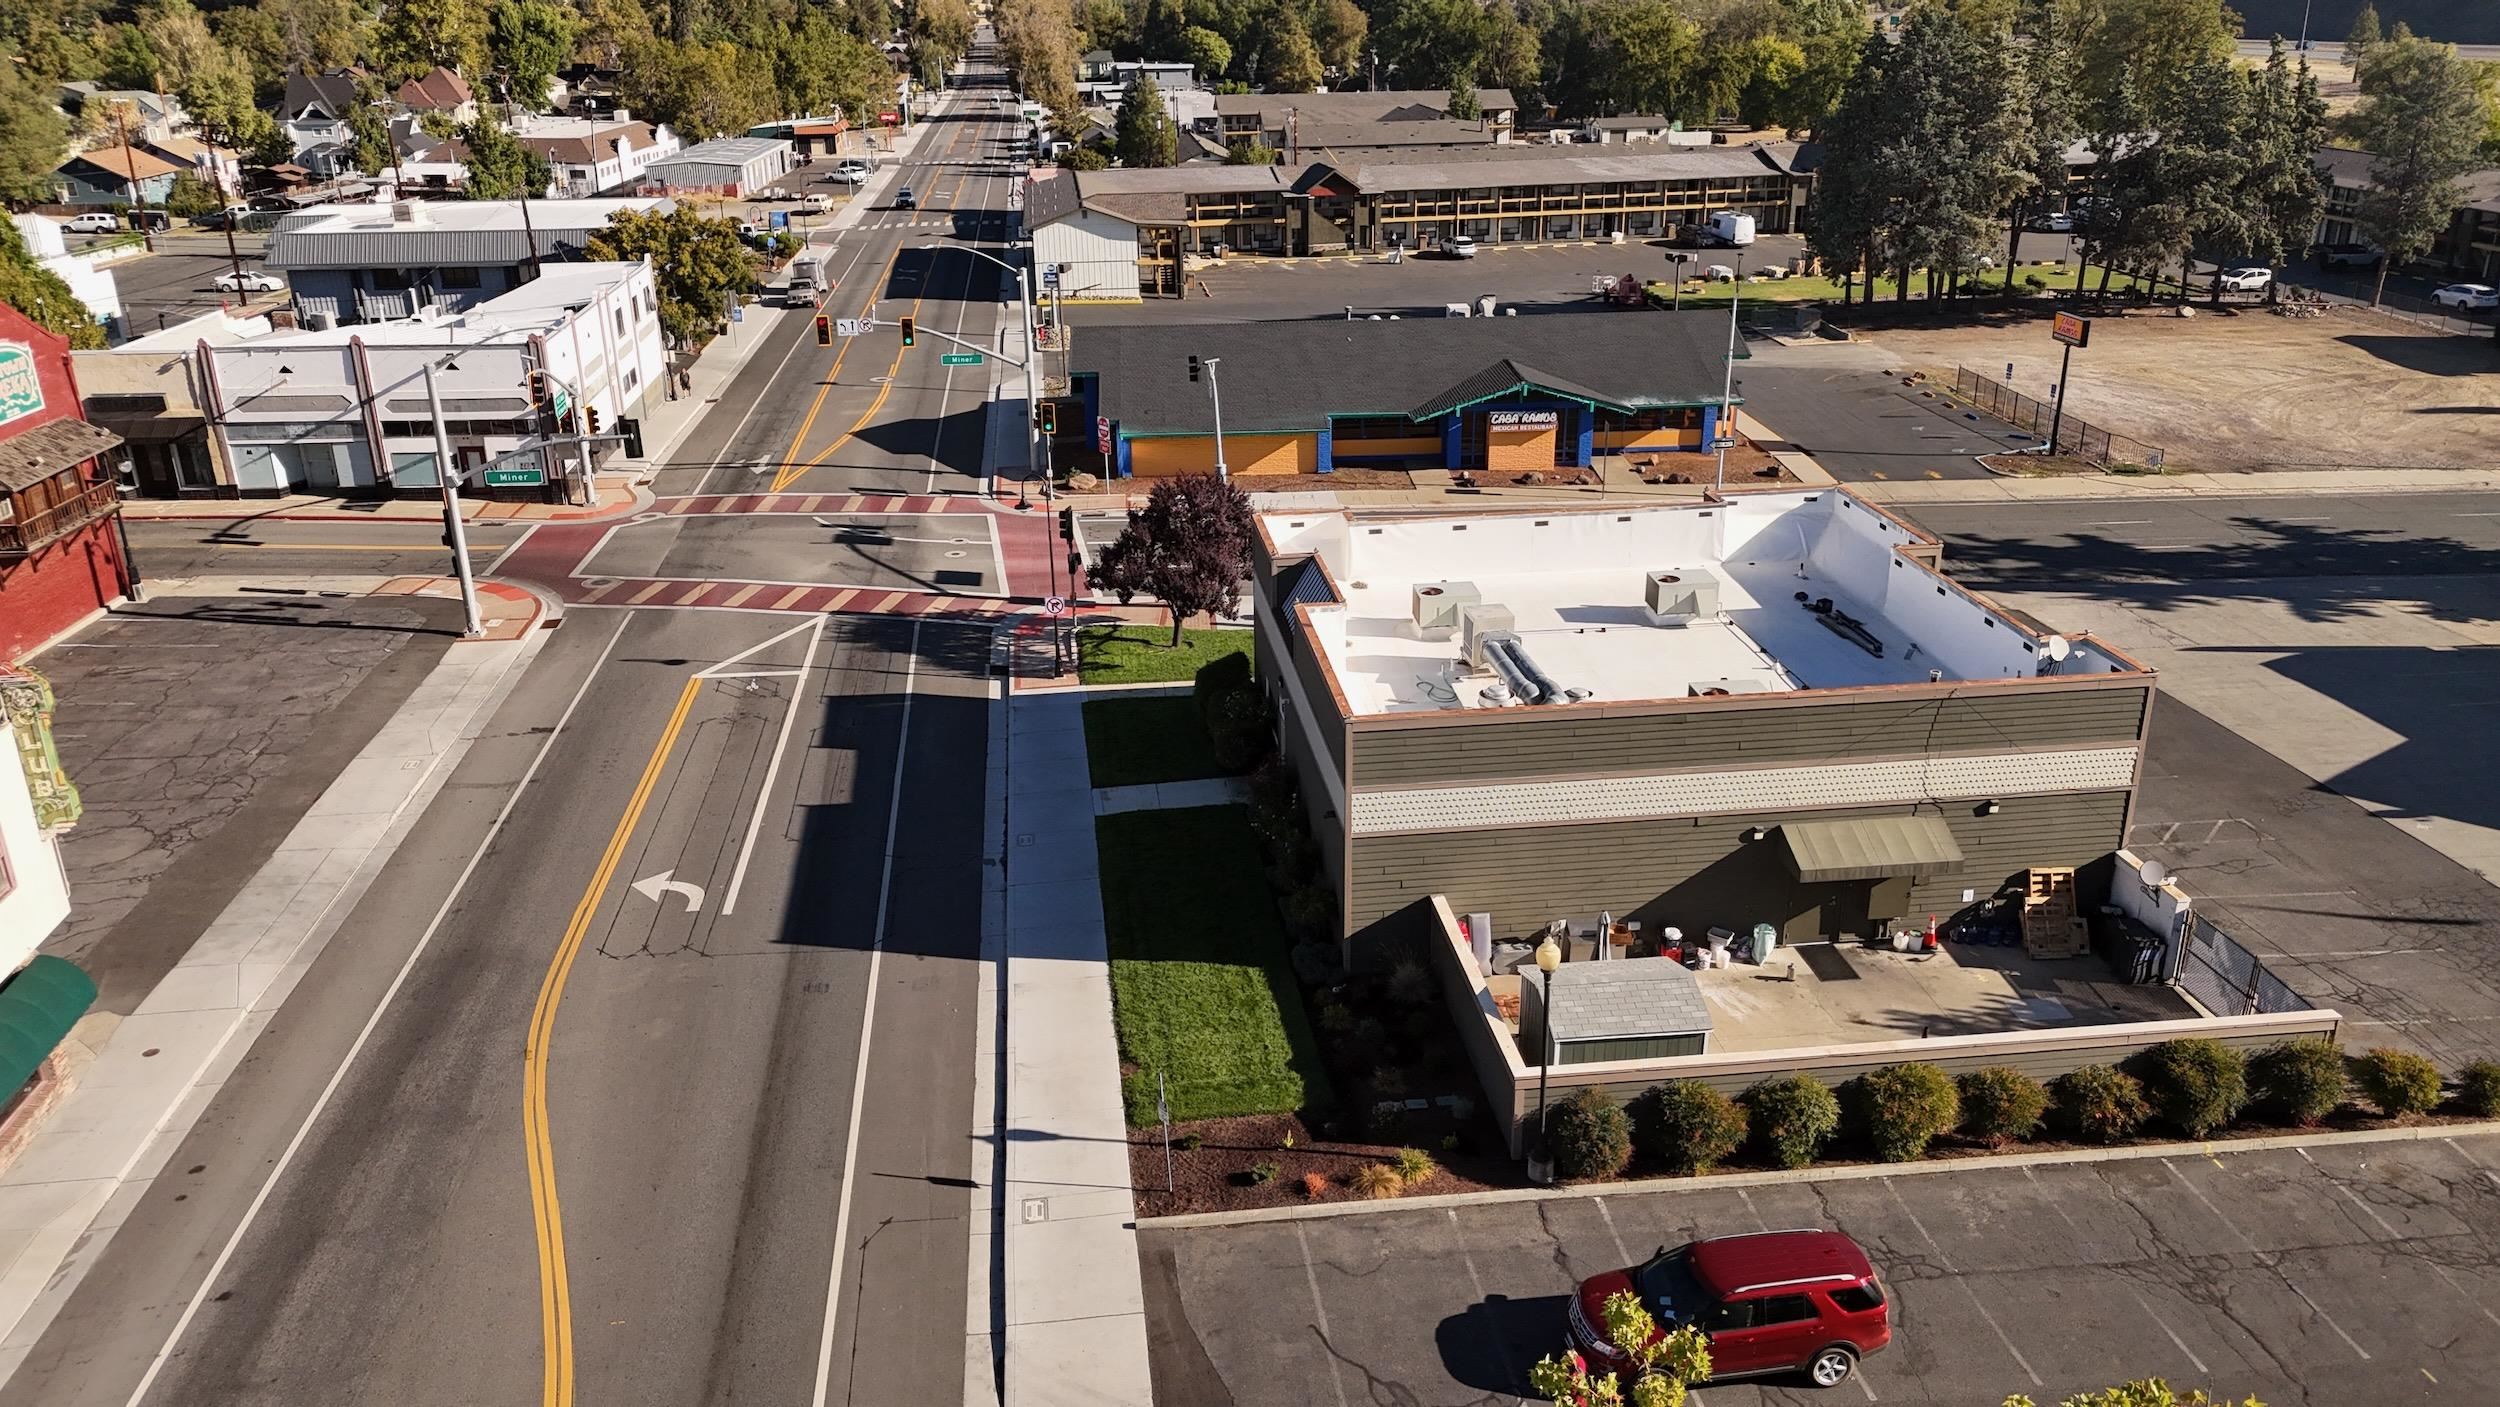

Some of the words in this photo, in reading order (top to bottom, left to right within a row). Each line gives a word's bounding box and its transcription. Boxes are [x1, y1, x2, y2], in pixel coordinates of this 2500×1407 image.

[951, 356, 974, 364] Miner
[1491, 413, 1519, 425] CASA
[1521, 412, 1558, 423] RAMOS
[499, 473, 529, 481] Miner
